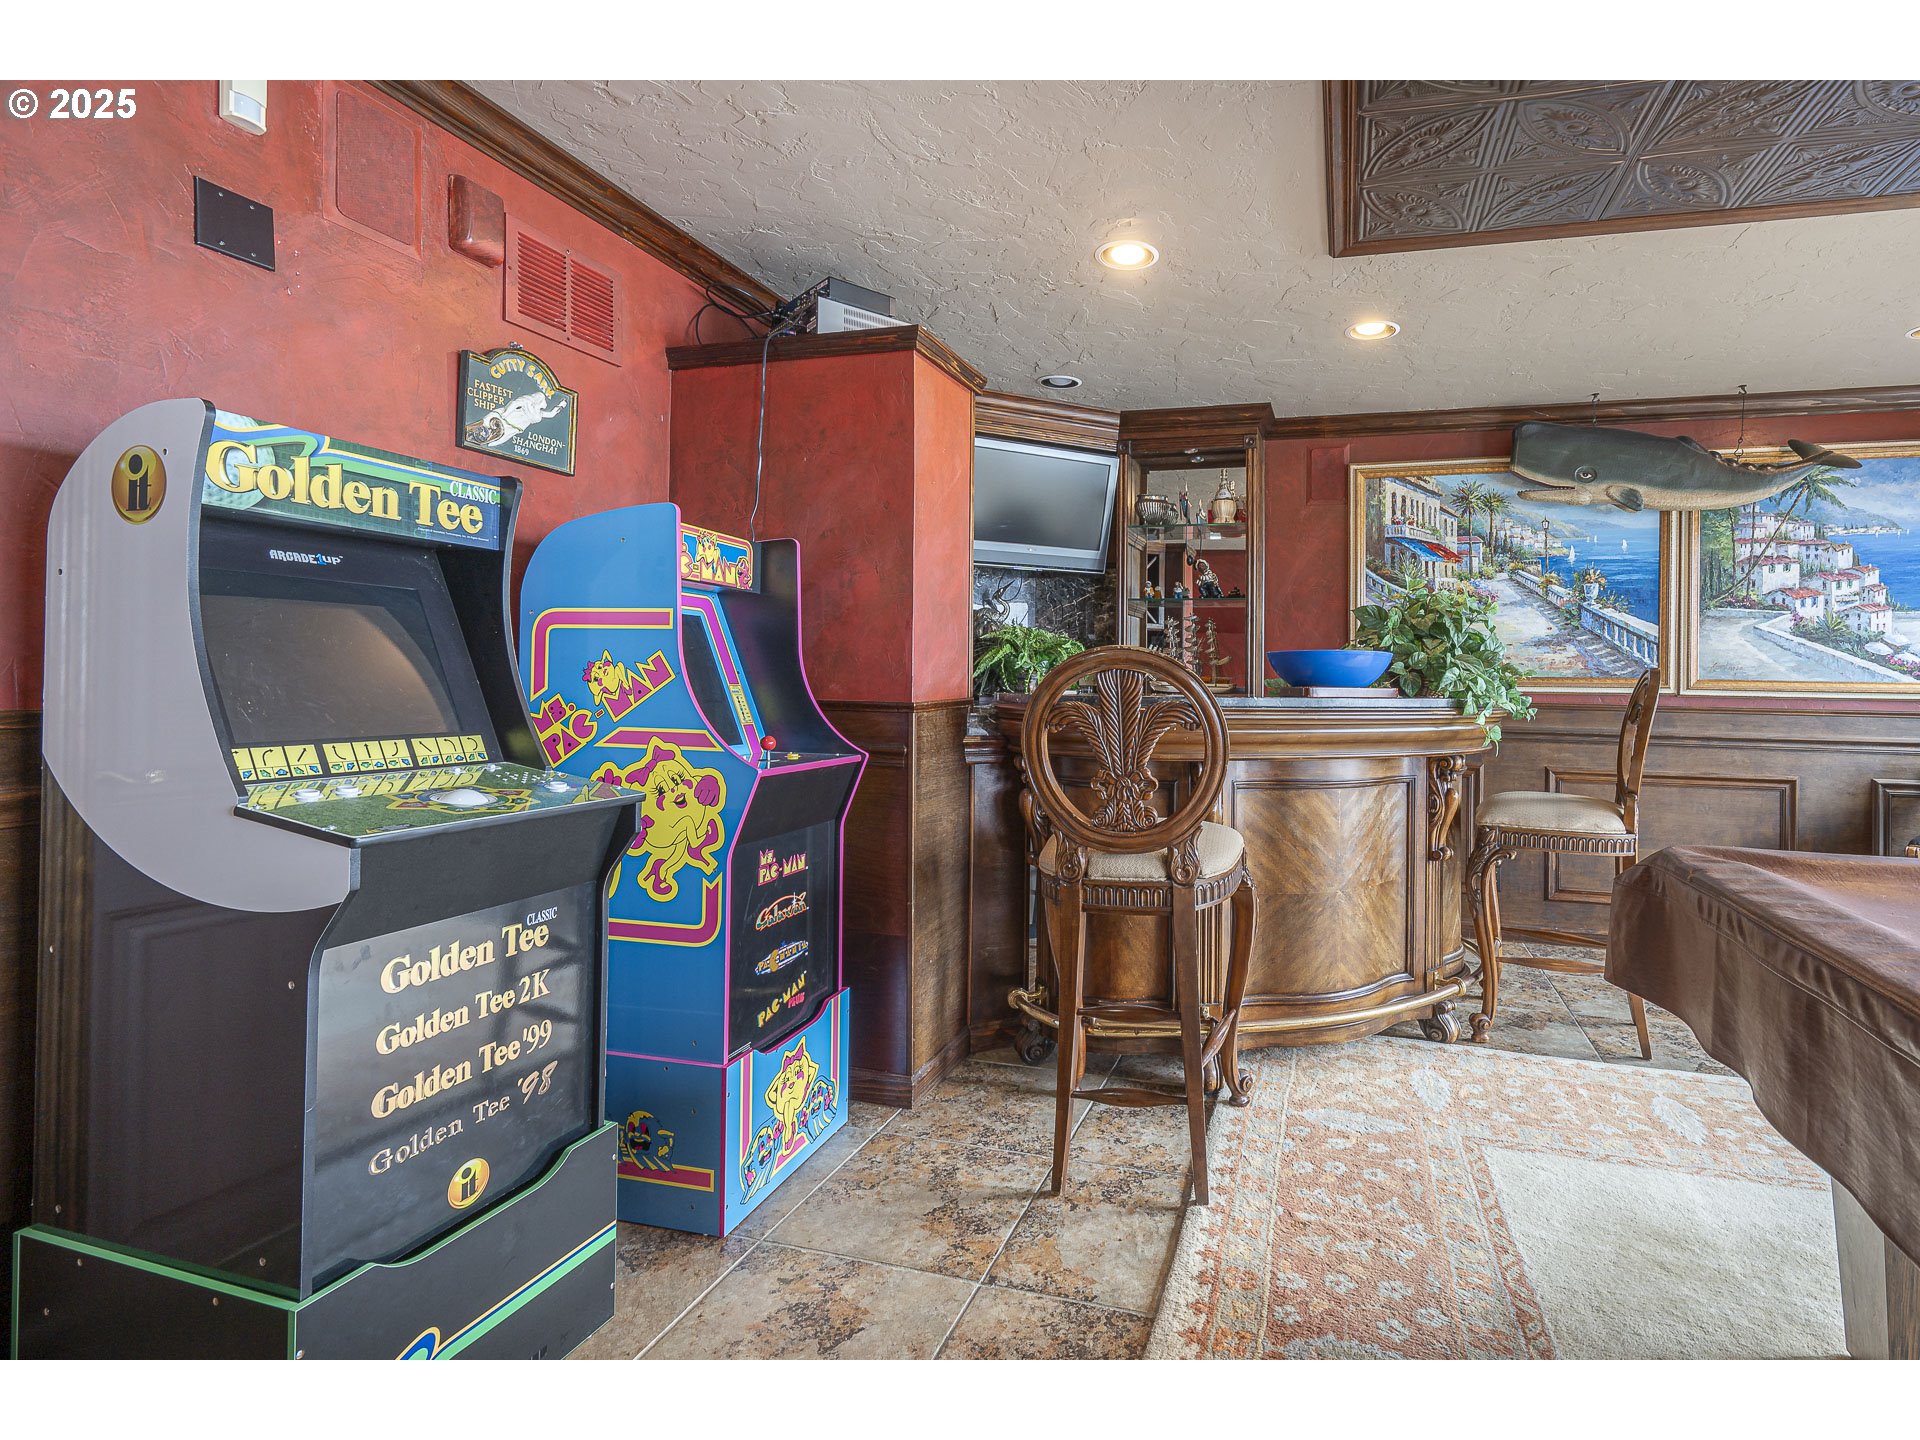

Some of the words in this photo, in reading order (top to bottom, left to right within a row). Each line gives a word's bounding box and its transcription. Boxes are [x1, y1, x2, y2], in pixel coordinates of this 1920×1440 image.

[467, 387, 505, 405] CLIPPER
[474, 379, 513, 399] FASTEST
[490, 359, 525, 379] CUTTY
[527, 365, 555, 399] SARK
[474, 398, 496, 411] SHIP
[512, 436, 558, 455] SHANGHAI
[514, 445, 530, 456] 1869
[528, 432, 566, 448] LONDON-
[206, 441, 402, 521] Golden
[409, 480, 484, 534] Tee
[450, 481, 497, 504] CLASSIC
[540, 650, 676, 768] PAC-MAN
[758, 853, 807, 887] PAC-MAN
[526, 907, 558, 926] CLASSIC
[380, 940, 496, 994] Golden
[502, 923, 550, 957] Tee
[375, 1008, 471, 1055] Golden
[475, 989, 516, 1019] Tee
[518, 969, 551, 1004] 2K
[757, 973, 806, 1028] PAC-MAN
[371, 1060, 473, 1119] Golden
[479, 1040, 521, 1073] Tee
[368, 1119, 464, 1176] Golden
[472, 1095, 511, 1124] Tee
